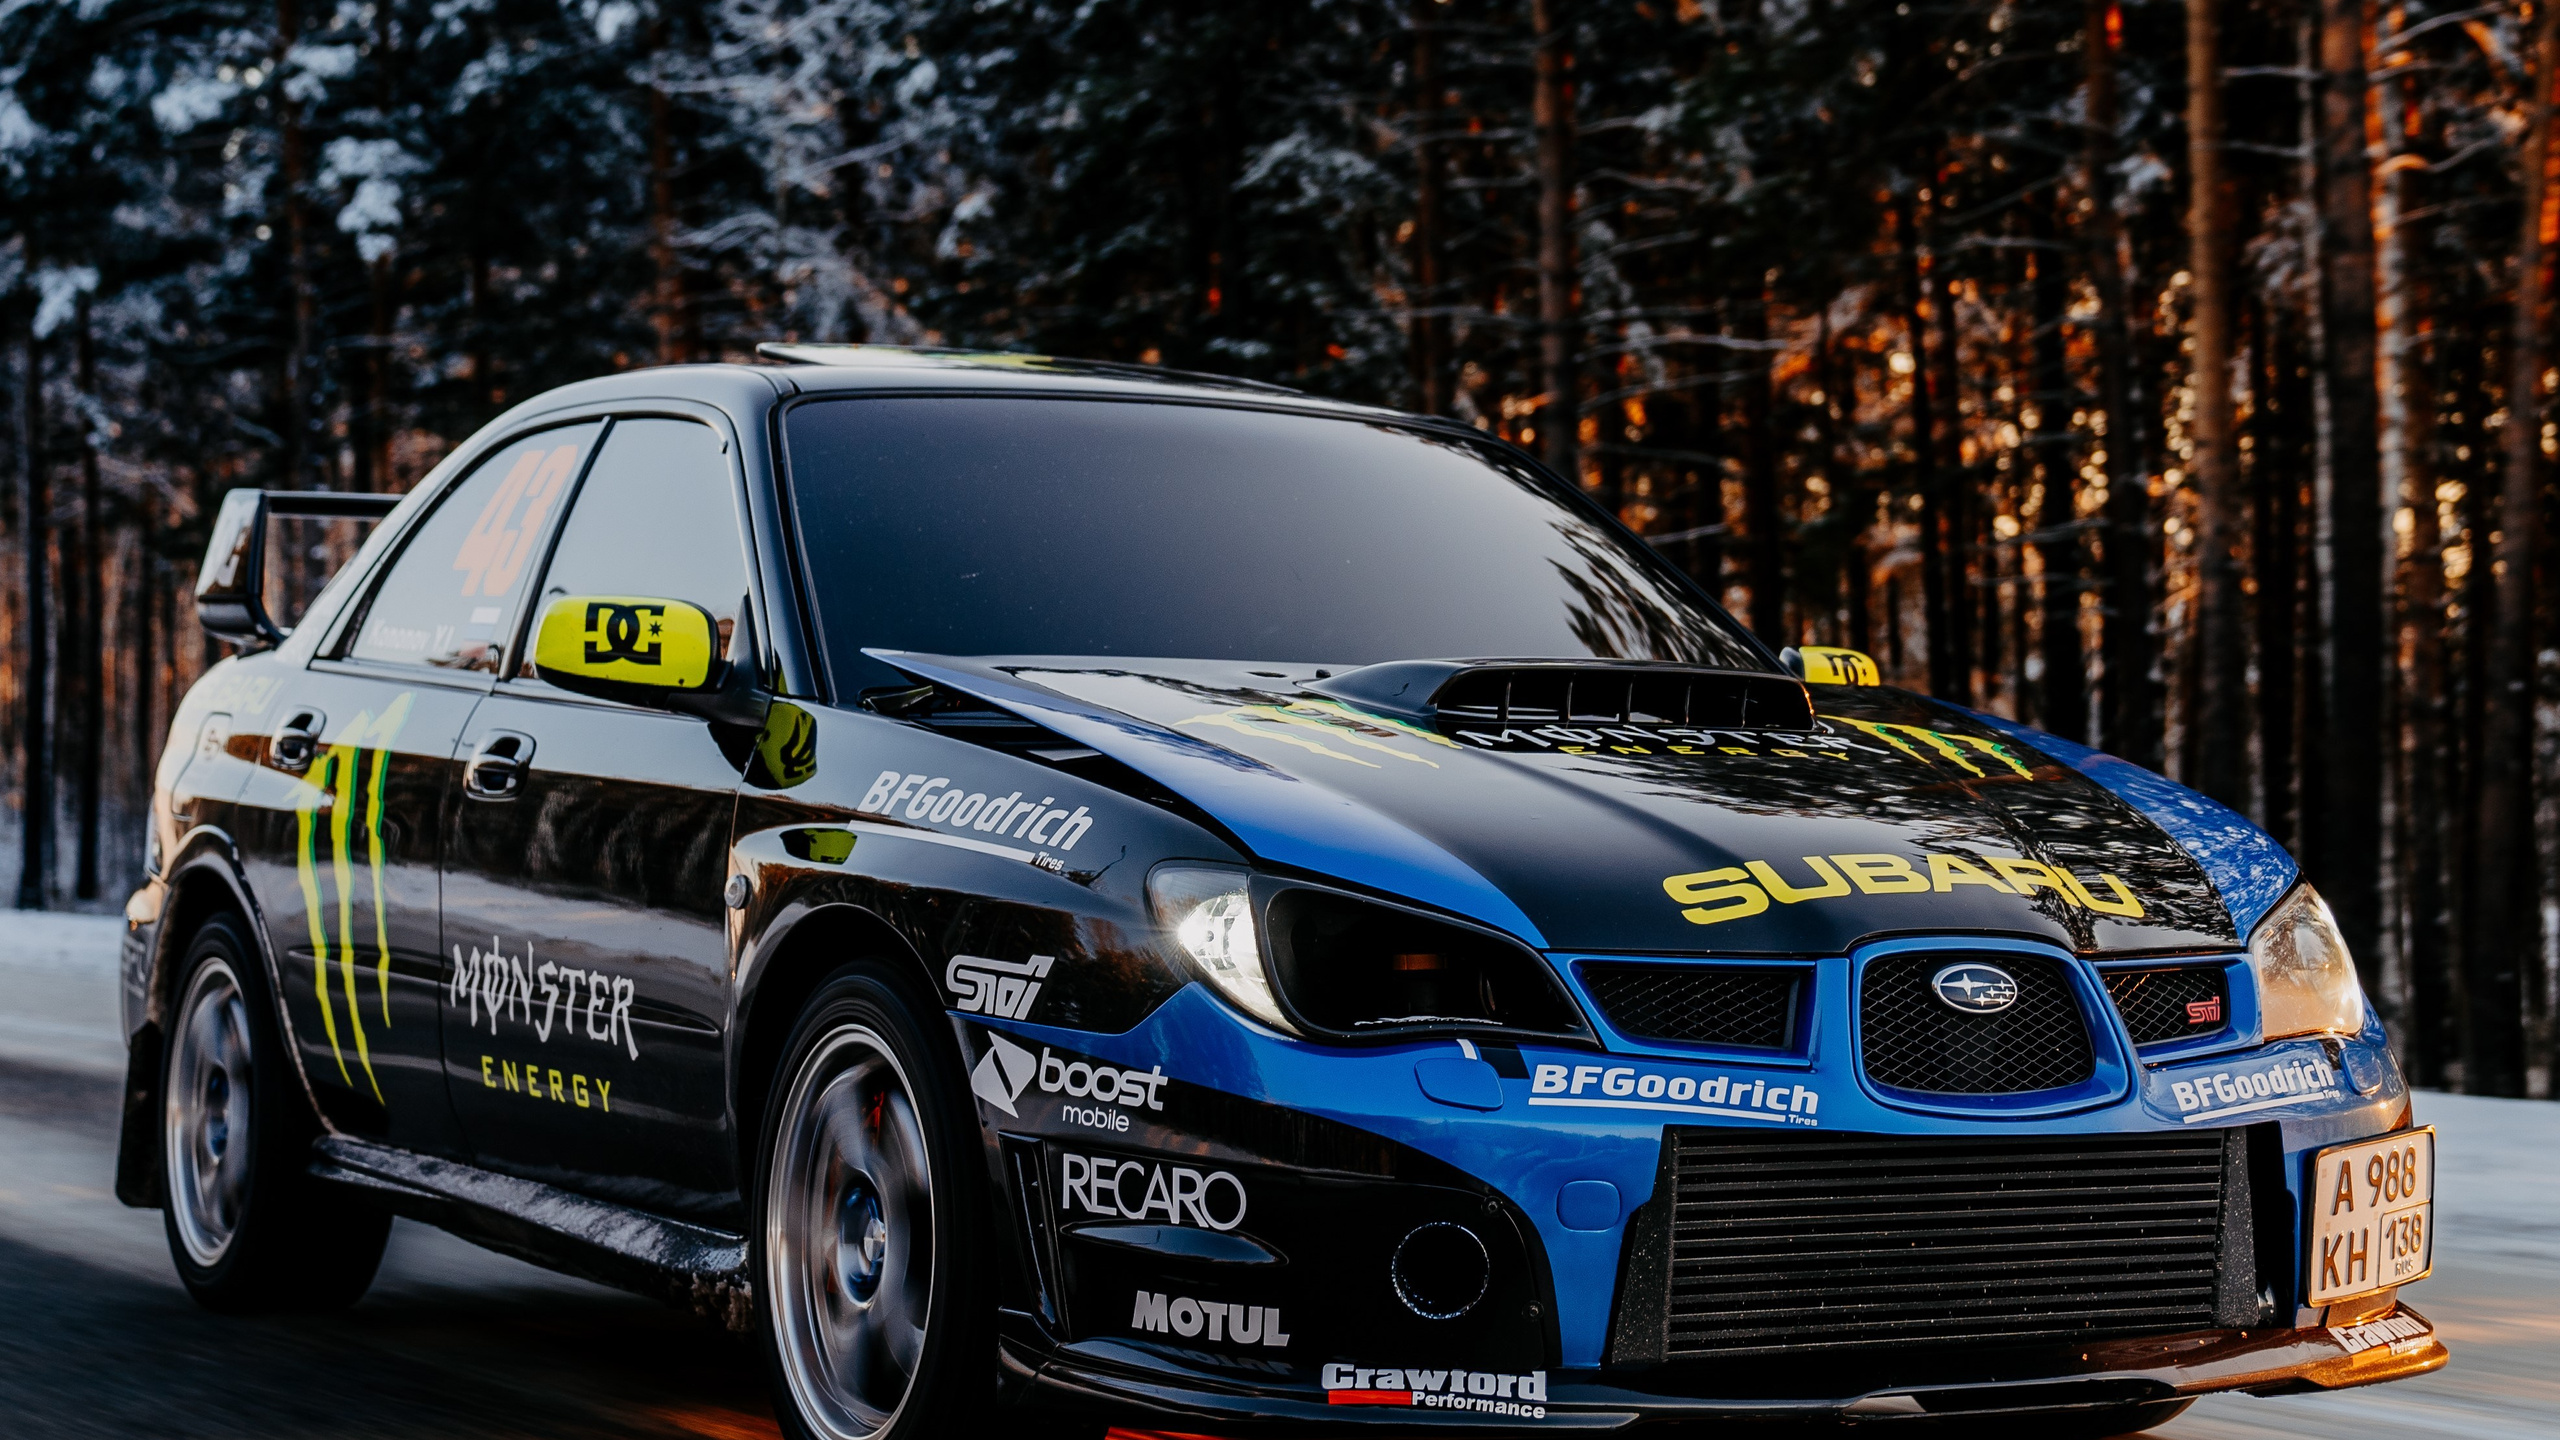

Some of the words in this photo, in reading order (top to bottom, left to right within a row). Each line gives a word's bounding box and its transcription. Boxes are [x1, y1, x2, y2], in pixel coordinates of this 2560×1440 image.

[453, 444, 579, 597] 43
[584, 602, 666, 666] DC
[1557, 745, 1849, 761] ENERGY
[856, 770, 1093, 851] BFGoodrich
[1034, 851, 1065, 871] Tires
[1662, 853, 2145, 925] SUBARU
[481, 1055, 611, 1113] ENERGY
[1038, 1047, 1169, 1111] boost
[1531, 1064, 1819, 1114] BFGoodrich
[2171, 1058, 2336, 1112] BFGoodrich
[1062, 1104, 1130, 1132] mobile
[1787, 1113, 1819, 1127] Tires
[1062, 1153, 1247, 1231] RECARO
[2332, 1157, 2354, 1216] A
[2368, 1142, 2417, 1207] 988
[2385, 1210, 2423, 1260] 138
[2395, 1258, 2414, 1276] RUS
[1131, 1290, 1290, 1346] MOTUL
[2328, 1311, 2431, 1354] Crawford
[1321, 1362, 1548, 1402] Crawford
[1411, 1390, 1547, 1420] Performance
